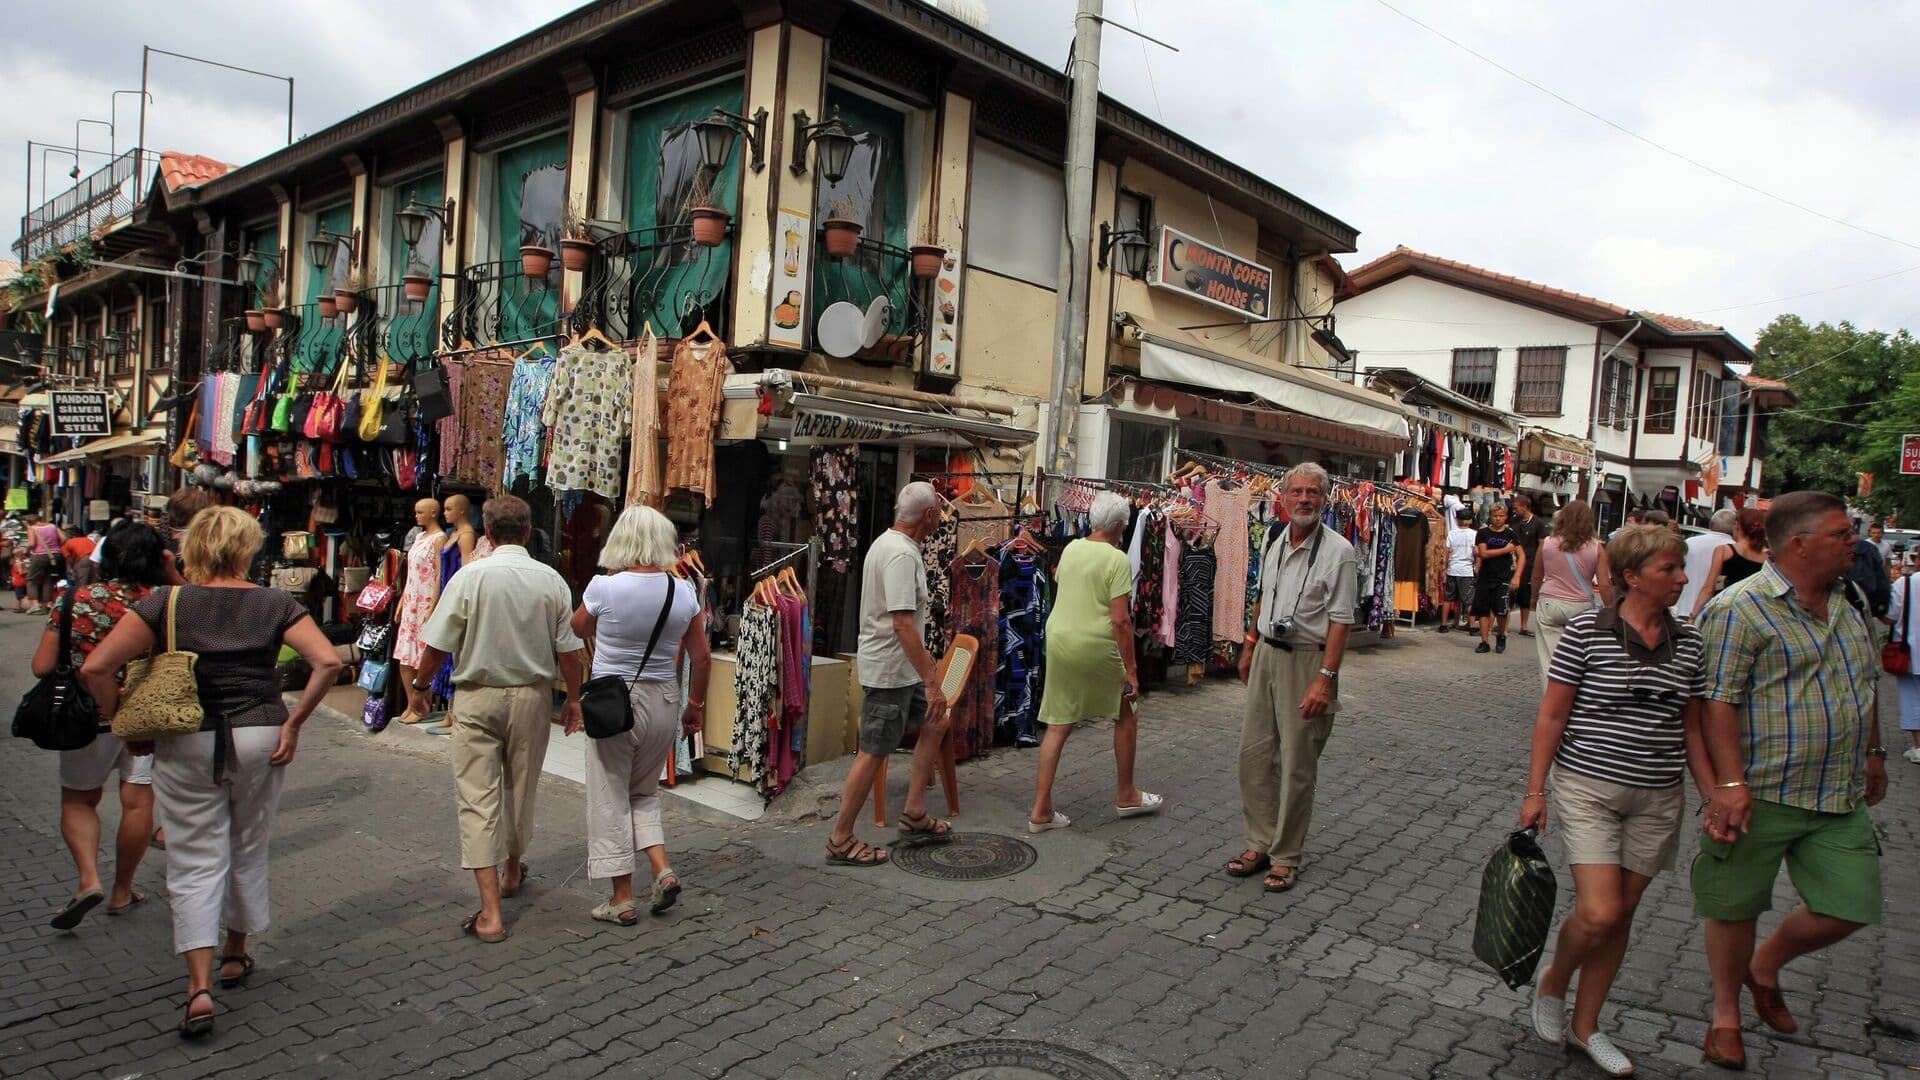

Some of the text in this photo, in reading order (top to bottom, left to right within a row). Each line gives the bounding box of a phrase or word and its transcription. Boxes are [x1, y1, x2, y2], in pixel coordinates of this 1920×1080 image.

[1185, 243, 1269, 290] MONTH COFFE
[1206, 279, 1249, 309] HOUSE
[55, 394, 103, 404] PANDORA
[57, 415, 105, 423] WATCH
[793, 411, 842, 438] ZAFER
[1904, 448, 1920, 458] SU
